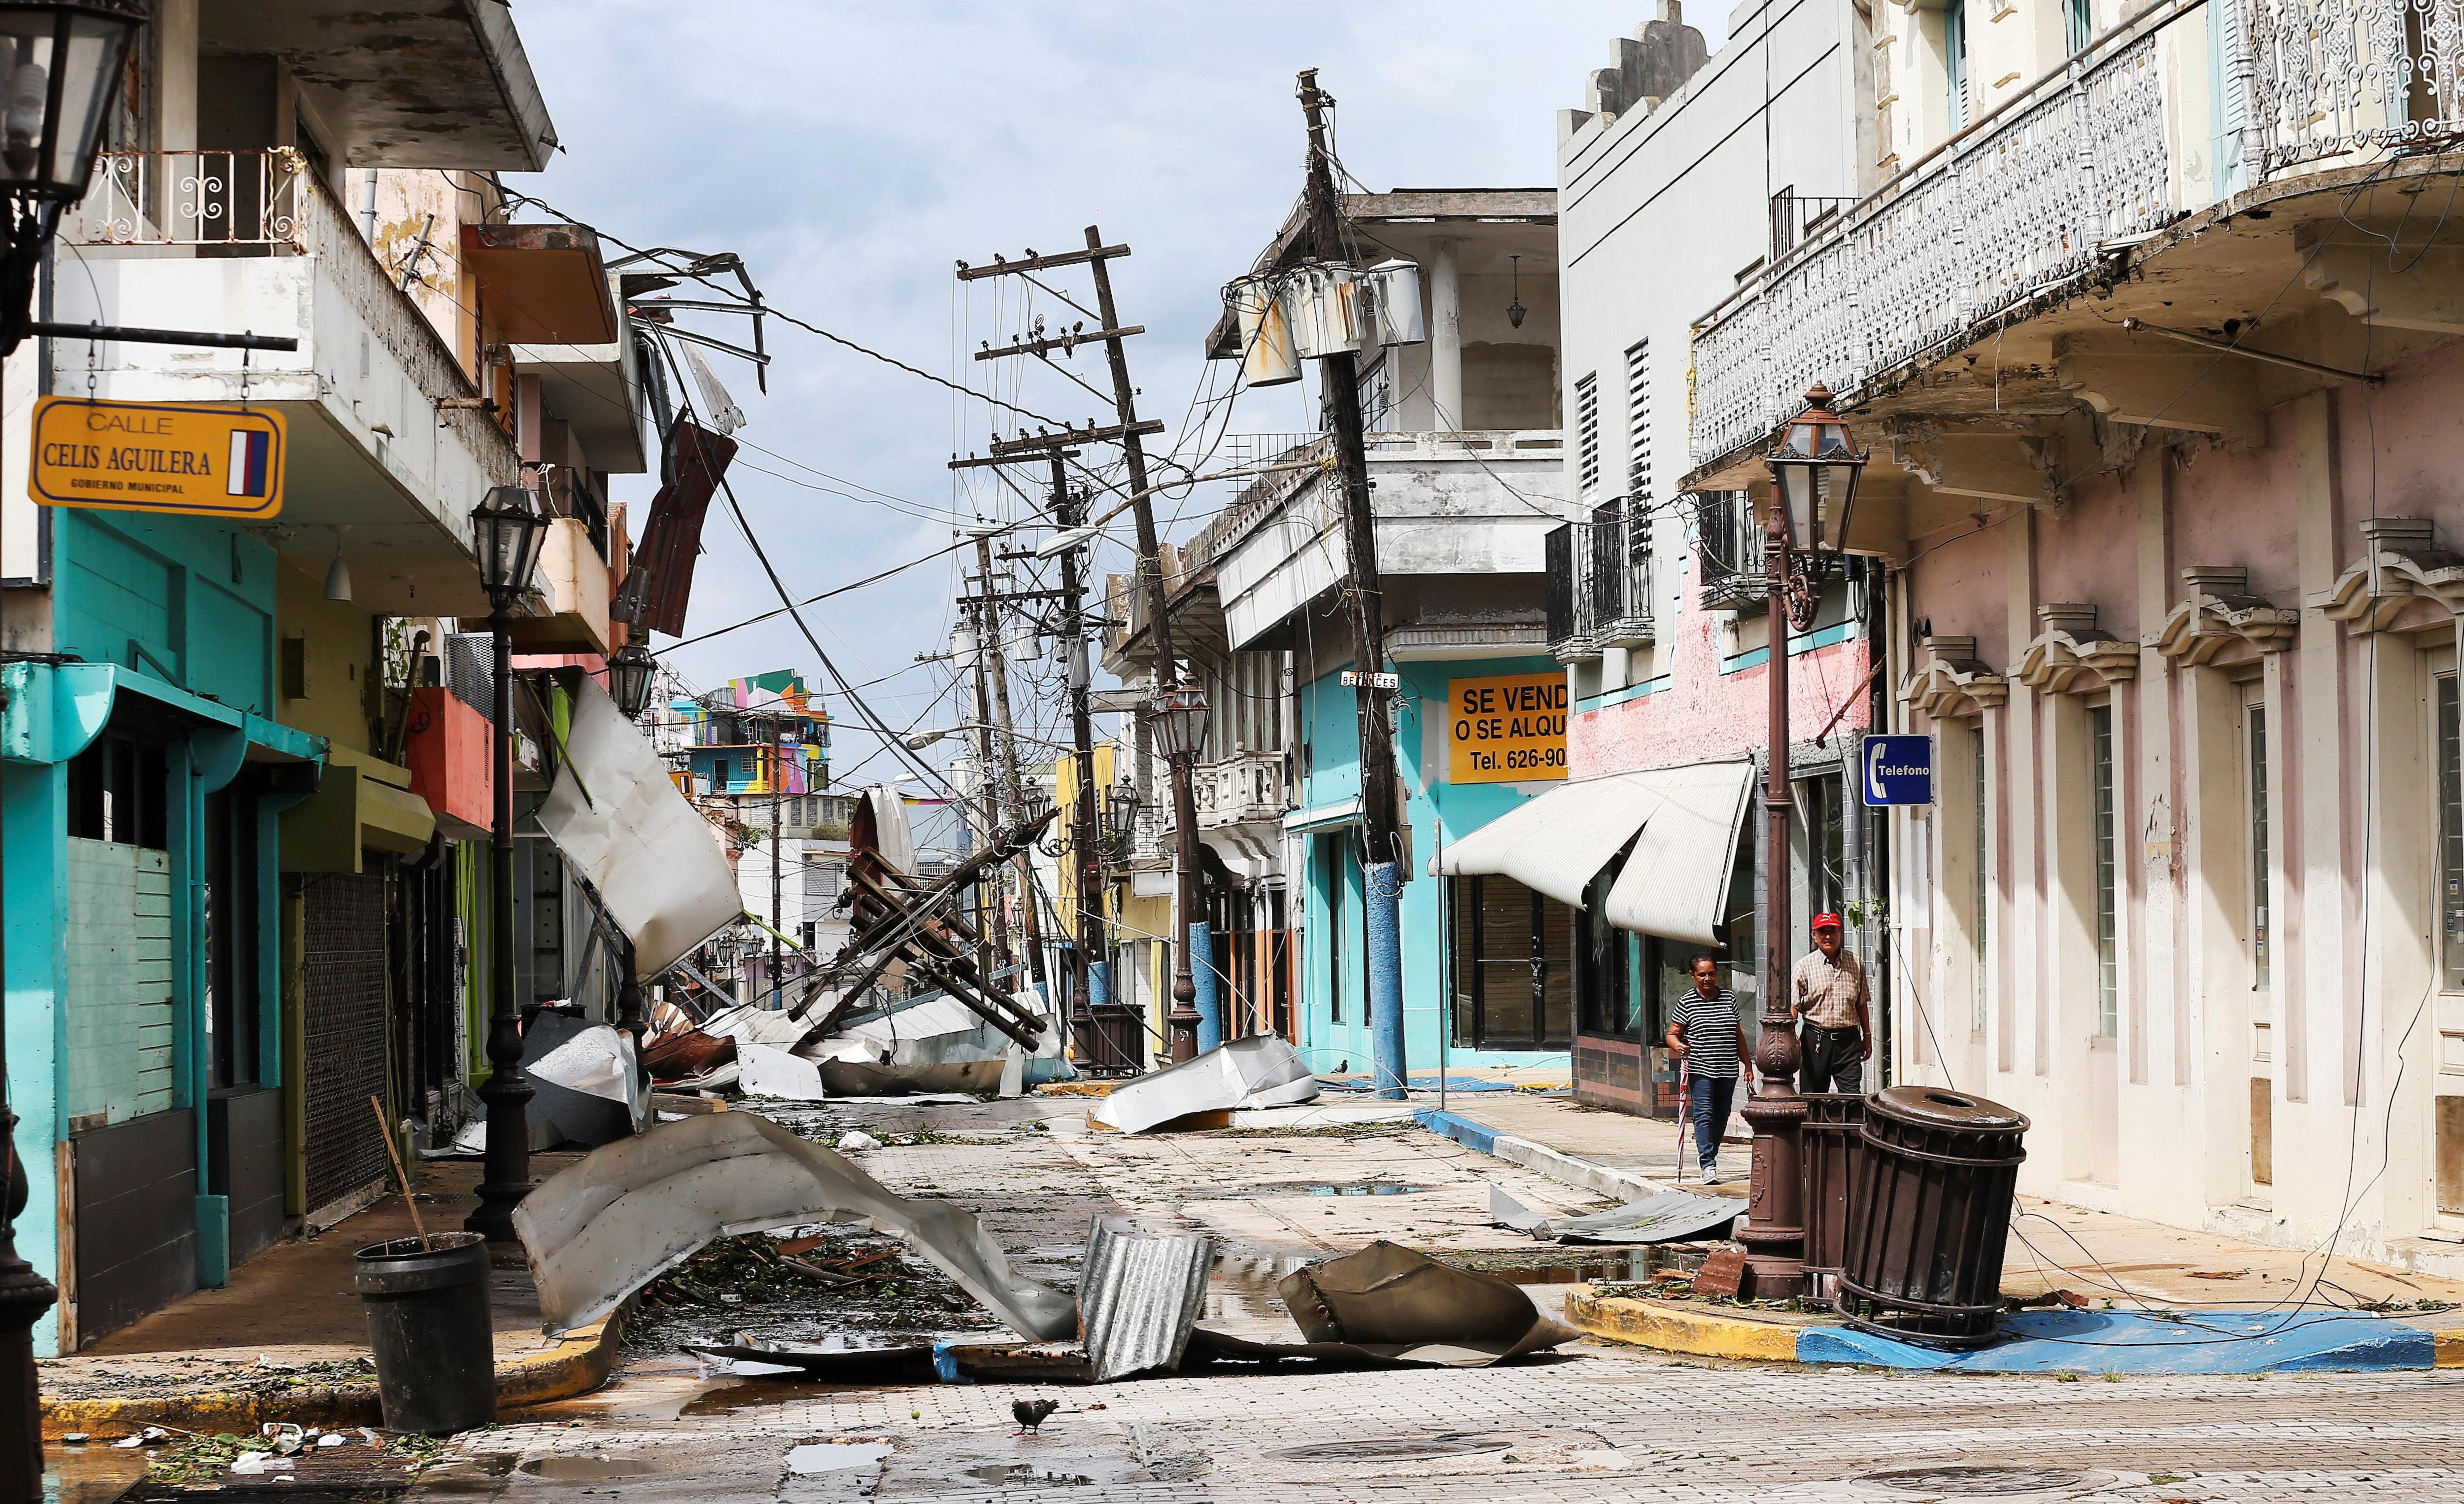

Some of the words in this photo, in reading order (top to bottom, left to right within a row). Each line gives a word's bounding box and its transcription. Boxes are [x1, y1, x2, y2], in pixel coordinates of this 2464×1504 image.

[87, 413, 173, 435] CALLE
[43, 442, 99, 469] CELIS
[106, 447, 211, 476] AGUILERA
[71, 478, 123, 490] GOBIERNO
[128, 482, 185, 494] MUNICIPAL
[1463, 688, 1495, 714] SE
[1503, 684, 1568, 712] VEND
[1455, 720, 1470, 741] O
[1476, 719, 1503, 740] SE
[1509, 715, 1566, 738] ALQU
[1470, 751, 1502, 770] Tel.
[1507, 747, 1566, 769] 626-90
[1878, 765, 1929, 776] Telefono
